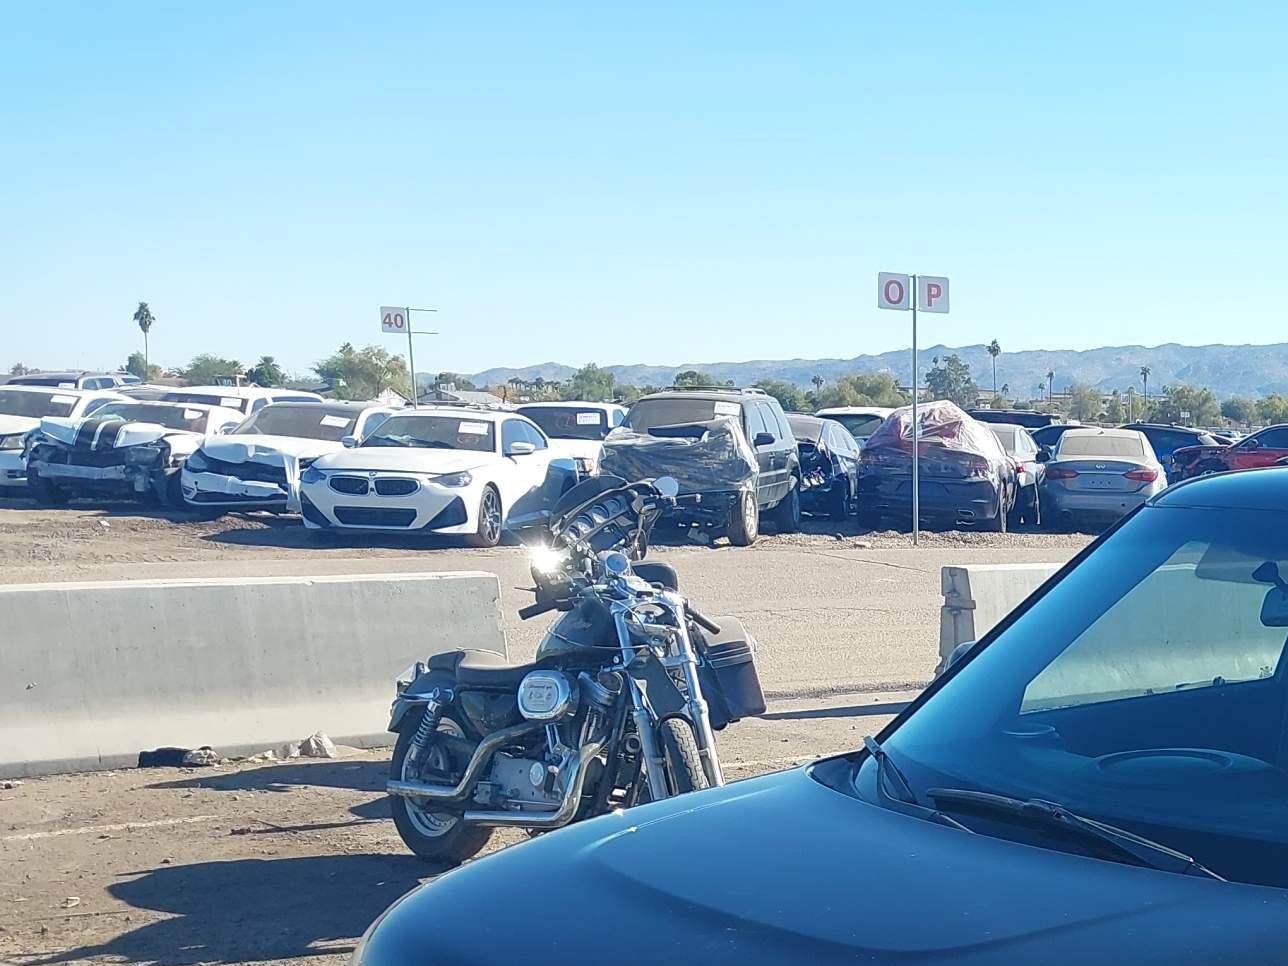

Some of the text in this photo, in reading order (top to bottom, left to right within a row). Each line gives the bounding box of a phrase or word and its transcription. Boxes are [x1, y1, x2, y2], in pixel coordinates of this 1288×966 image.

[884, 279, 904, 305] O
[927, 283, 942, 307] P
[383, 313, 404, 328] 40
